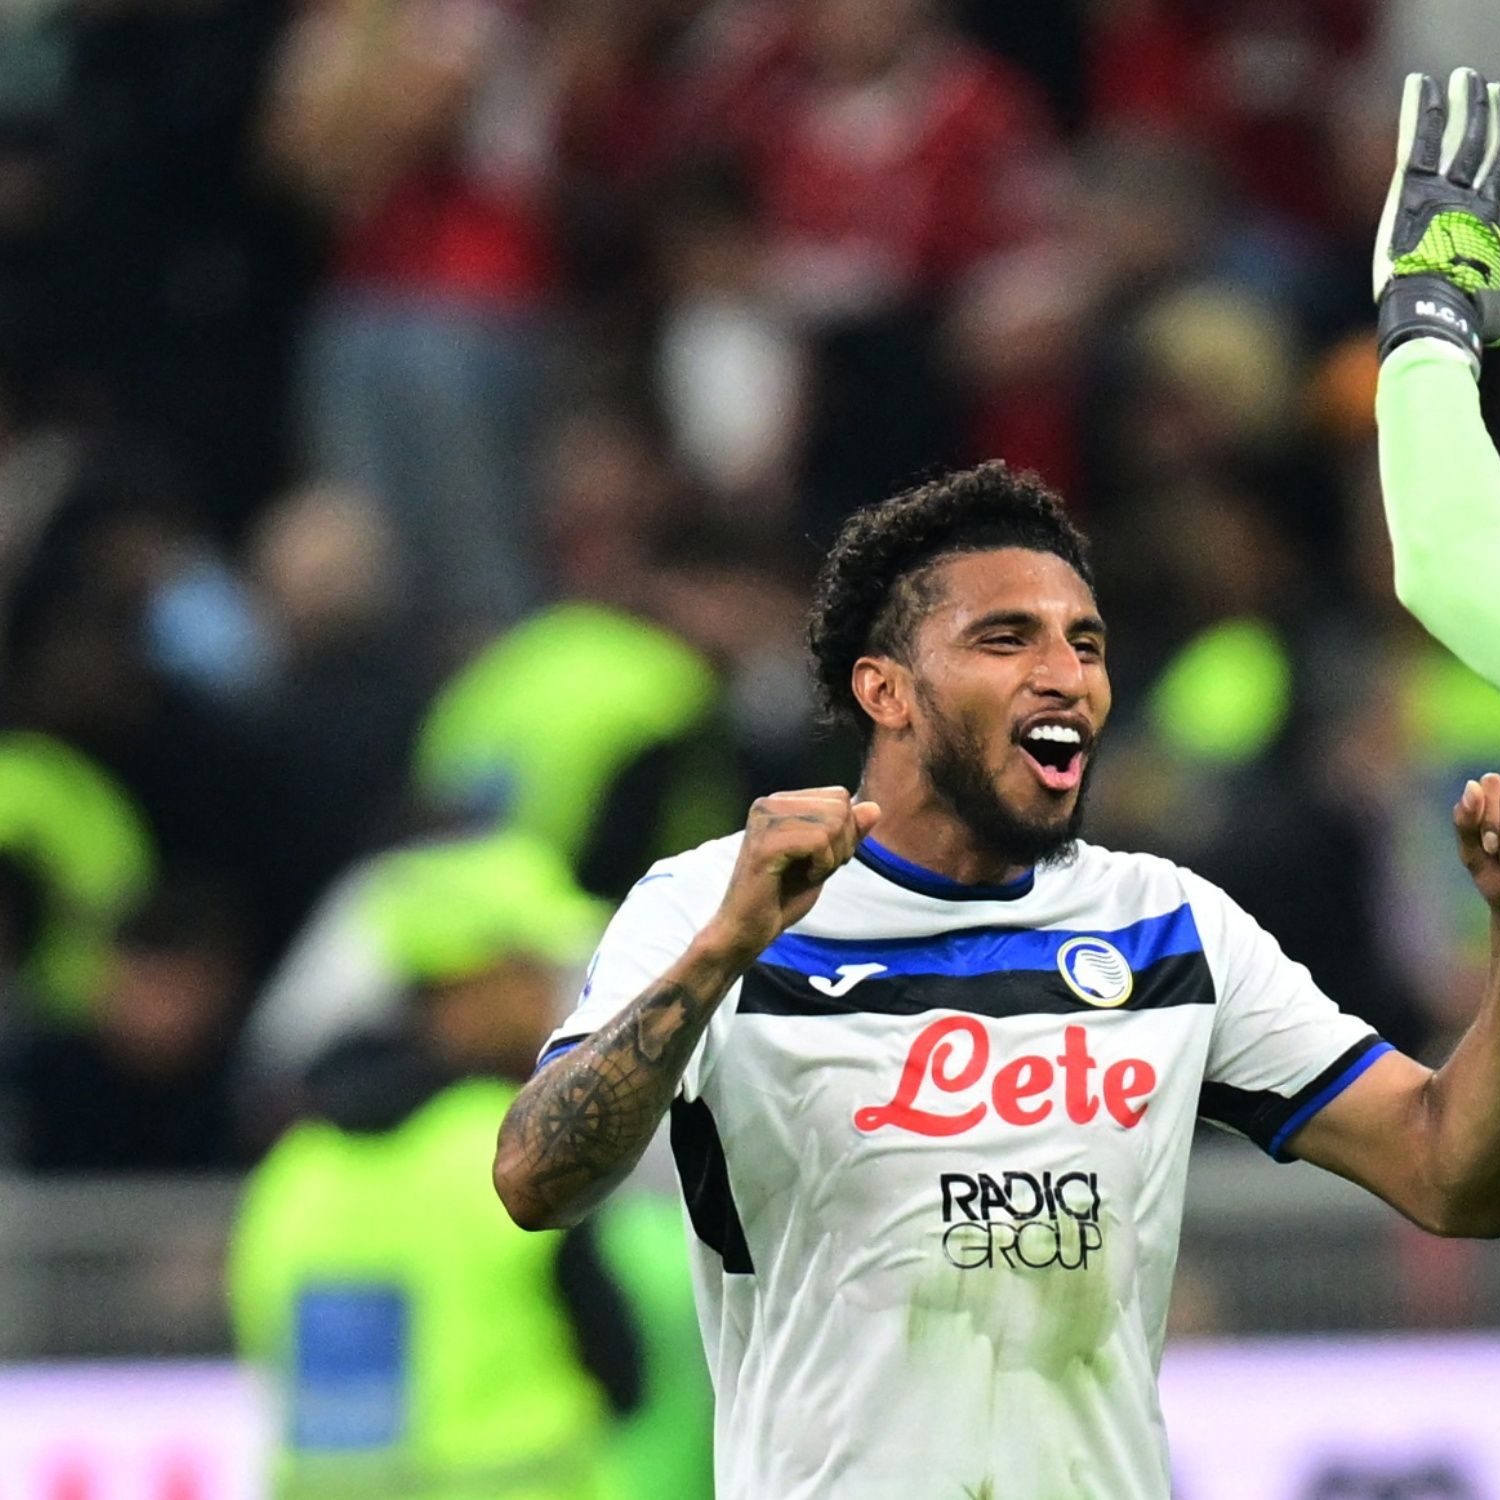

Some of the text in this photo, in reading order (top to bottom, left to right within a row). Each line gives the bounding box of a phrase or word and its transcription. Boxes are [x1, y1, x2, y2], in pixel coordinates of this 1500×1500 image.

[853, 1015, 1156, 1137] Lete
[940, 1171, 1101, 1222] RADICI
[943, 1221, 1103, 1270] GROUP
